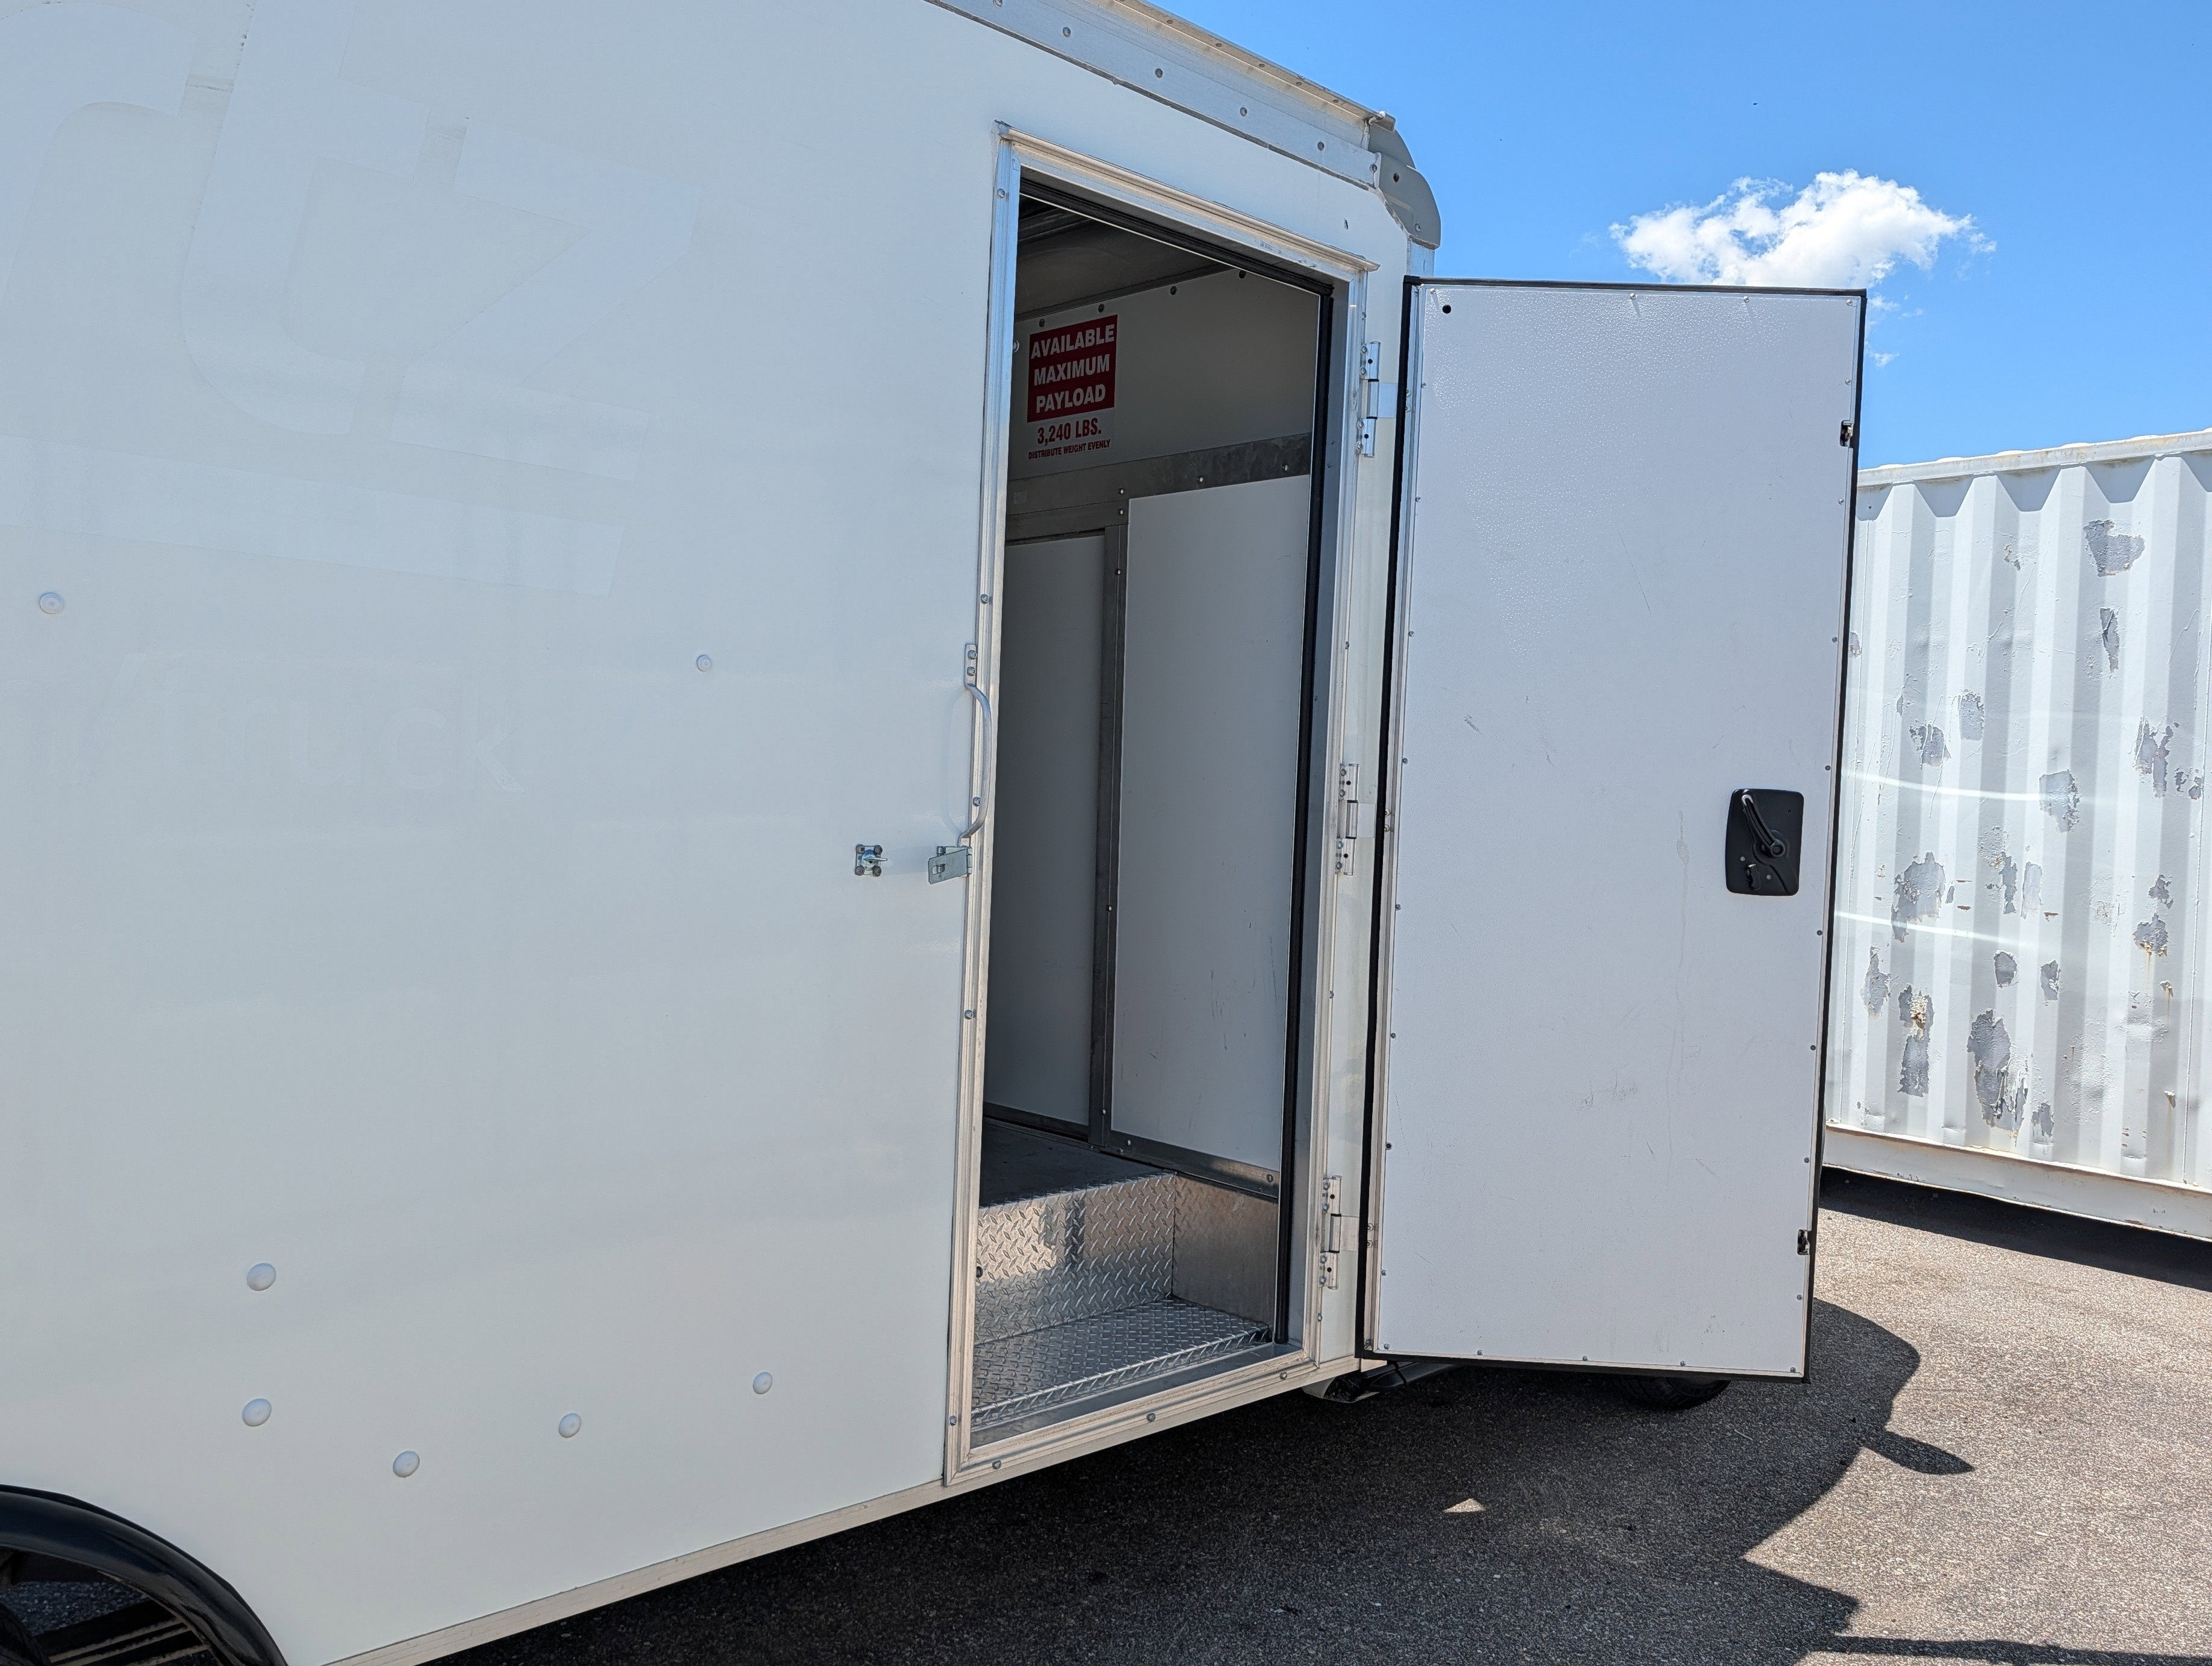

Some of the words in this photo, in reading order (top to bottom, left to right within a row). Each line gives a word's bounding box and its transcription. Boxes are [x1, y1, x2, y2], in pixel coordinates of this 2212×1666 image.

[1031, 324, 1115, 359] AVAILABLE
[1034, 354, 1110, 386] MAXIMUM
[1036, 383, 1106, 413] PAYLOAD
[1037, 422, 1071, 446] 3,240
[1075, 418, 1102, 438] LBS.
[1028, 446, 1062, 460] DISTRIBUTE
[1063, 443, 1086, 454] WEIGHT
[1088, 439, 1111, 450] EVENLY
